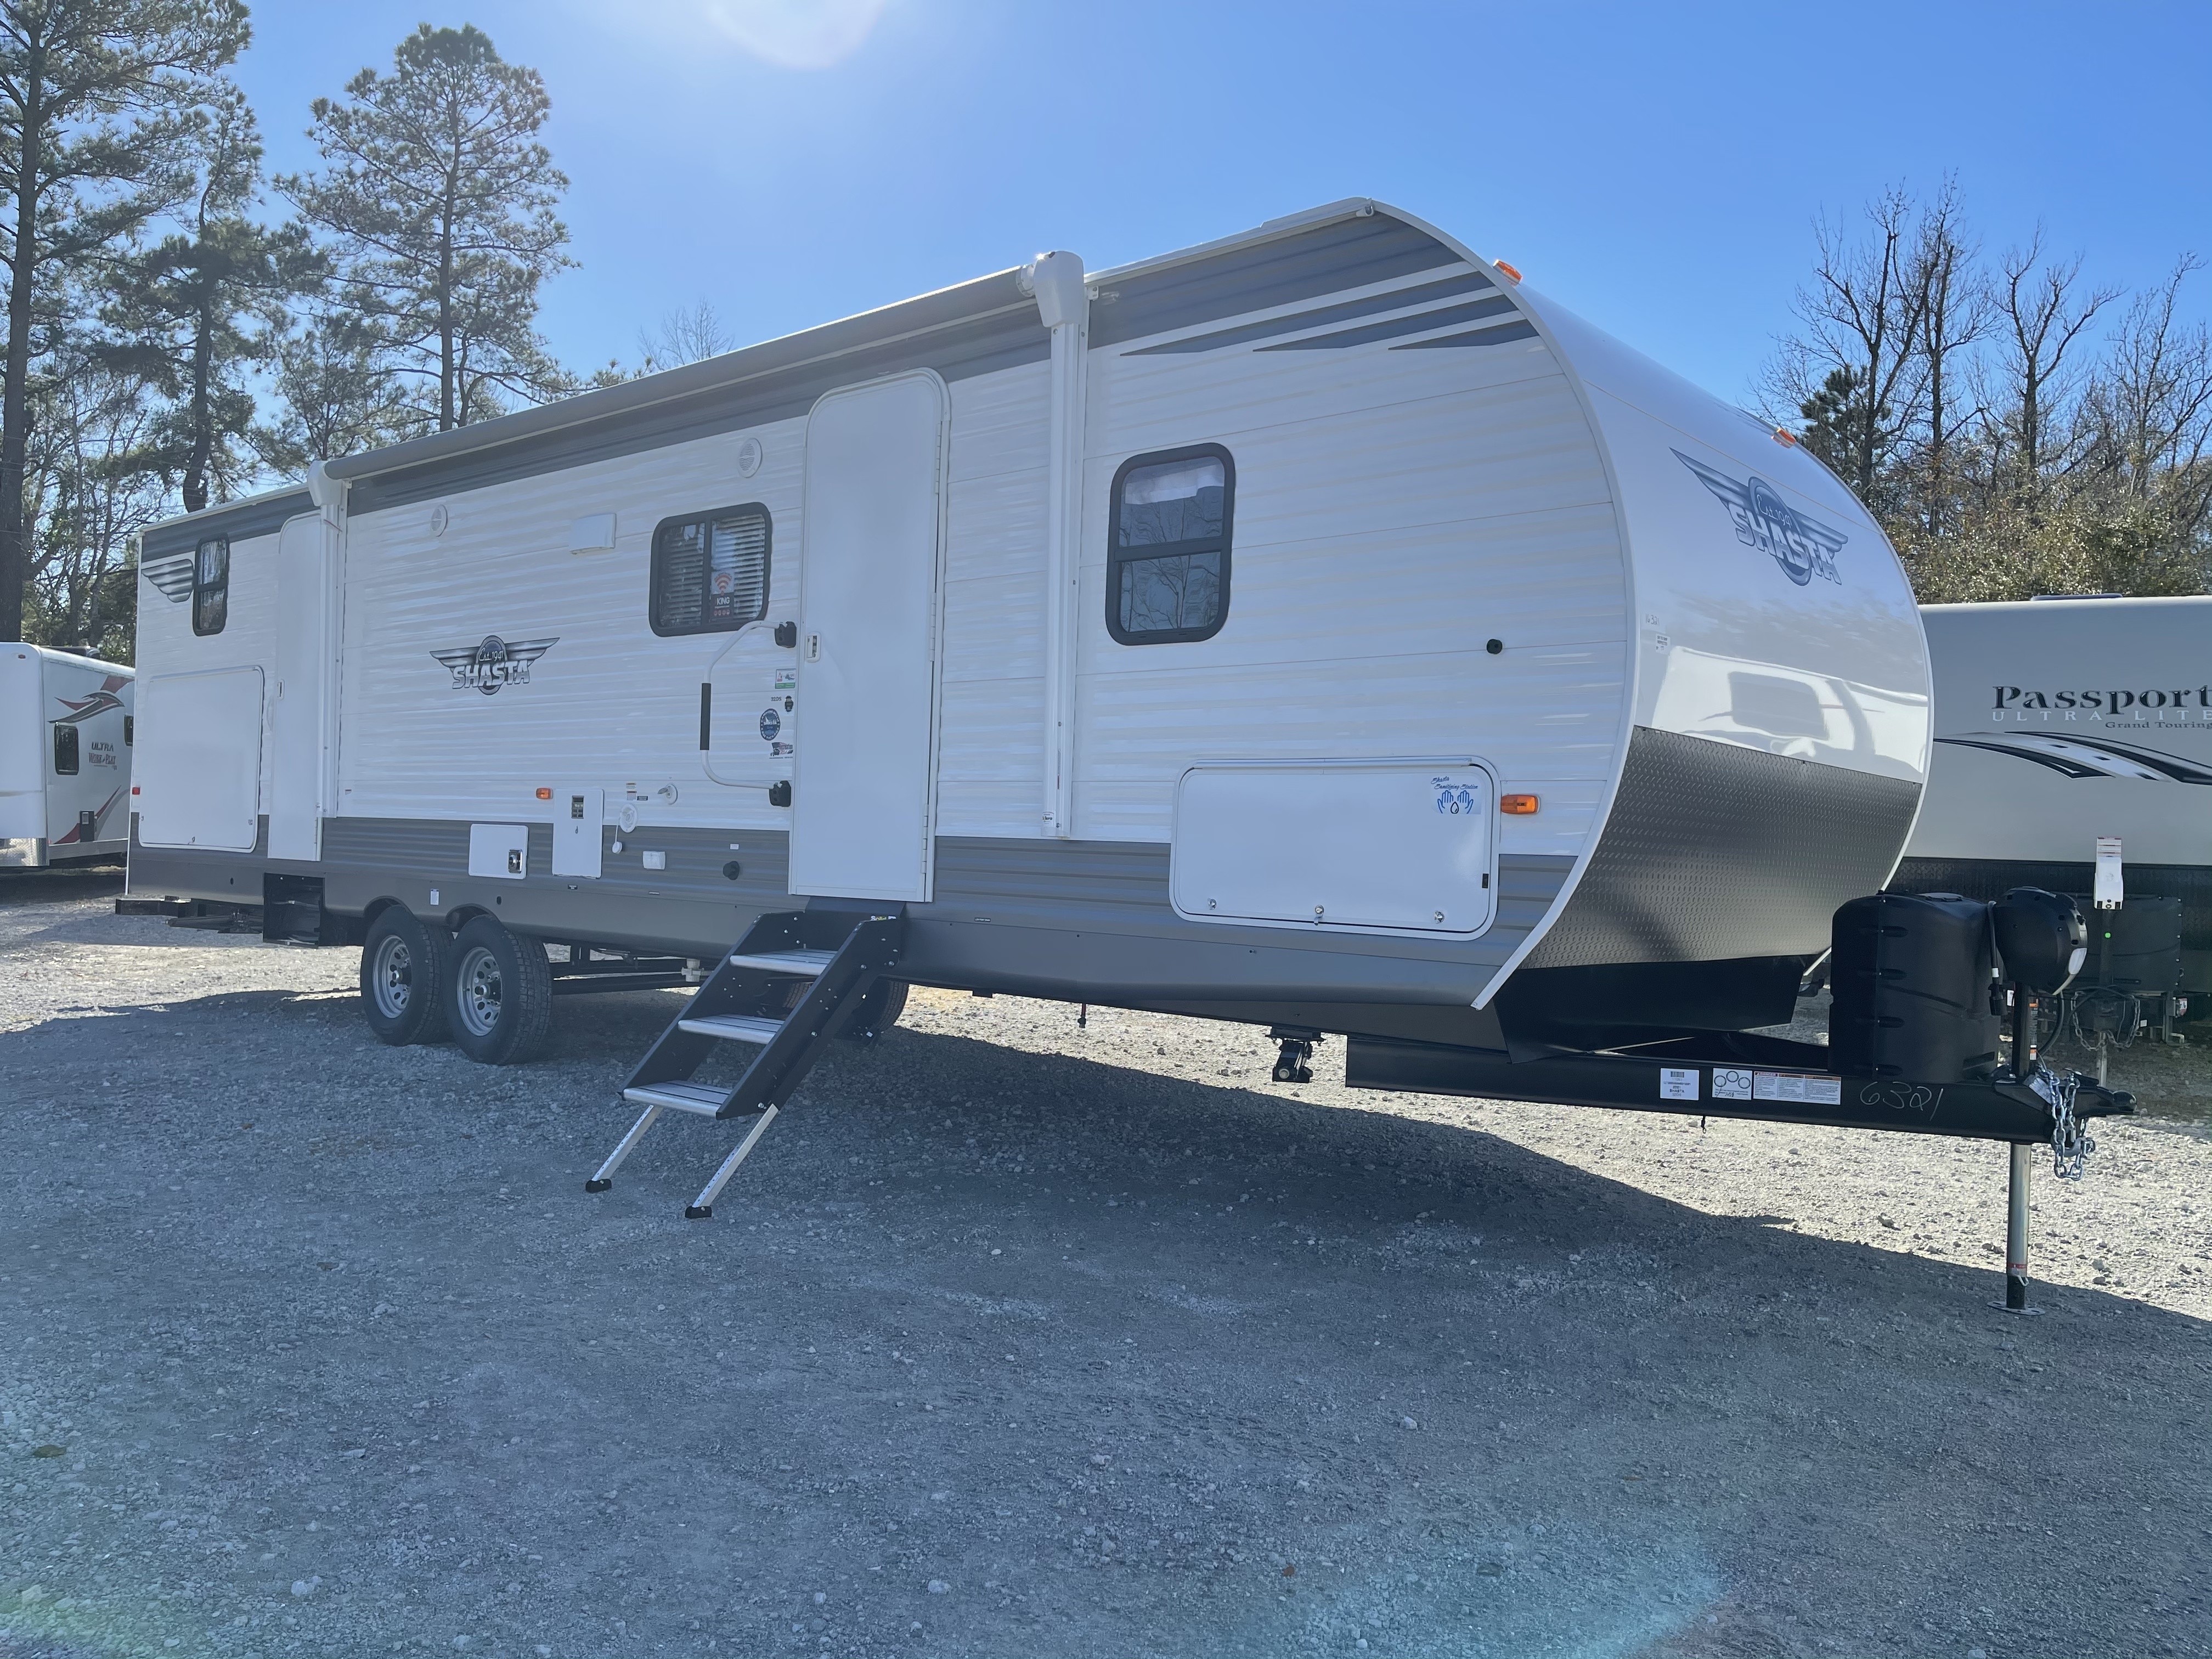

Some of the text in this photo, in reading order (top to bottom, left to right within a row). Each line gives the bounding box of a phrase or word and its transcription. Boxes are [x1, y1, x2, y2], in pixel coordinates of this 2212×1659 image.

[1728, 502, 1842, 586] SHASTA
[716, 597, 730, 605] KING
[452, 659, 531, 690] SHASTA
[1991, 685, 2212, 715] Passport
[1992, 709, 2212, 721] ULTRA LITE
[2154, 721, 2212, 730] Touring
[91, 741, 114, 752] ULTRA
[1860, 1081, 1944, 1121] 6321
